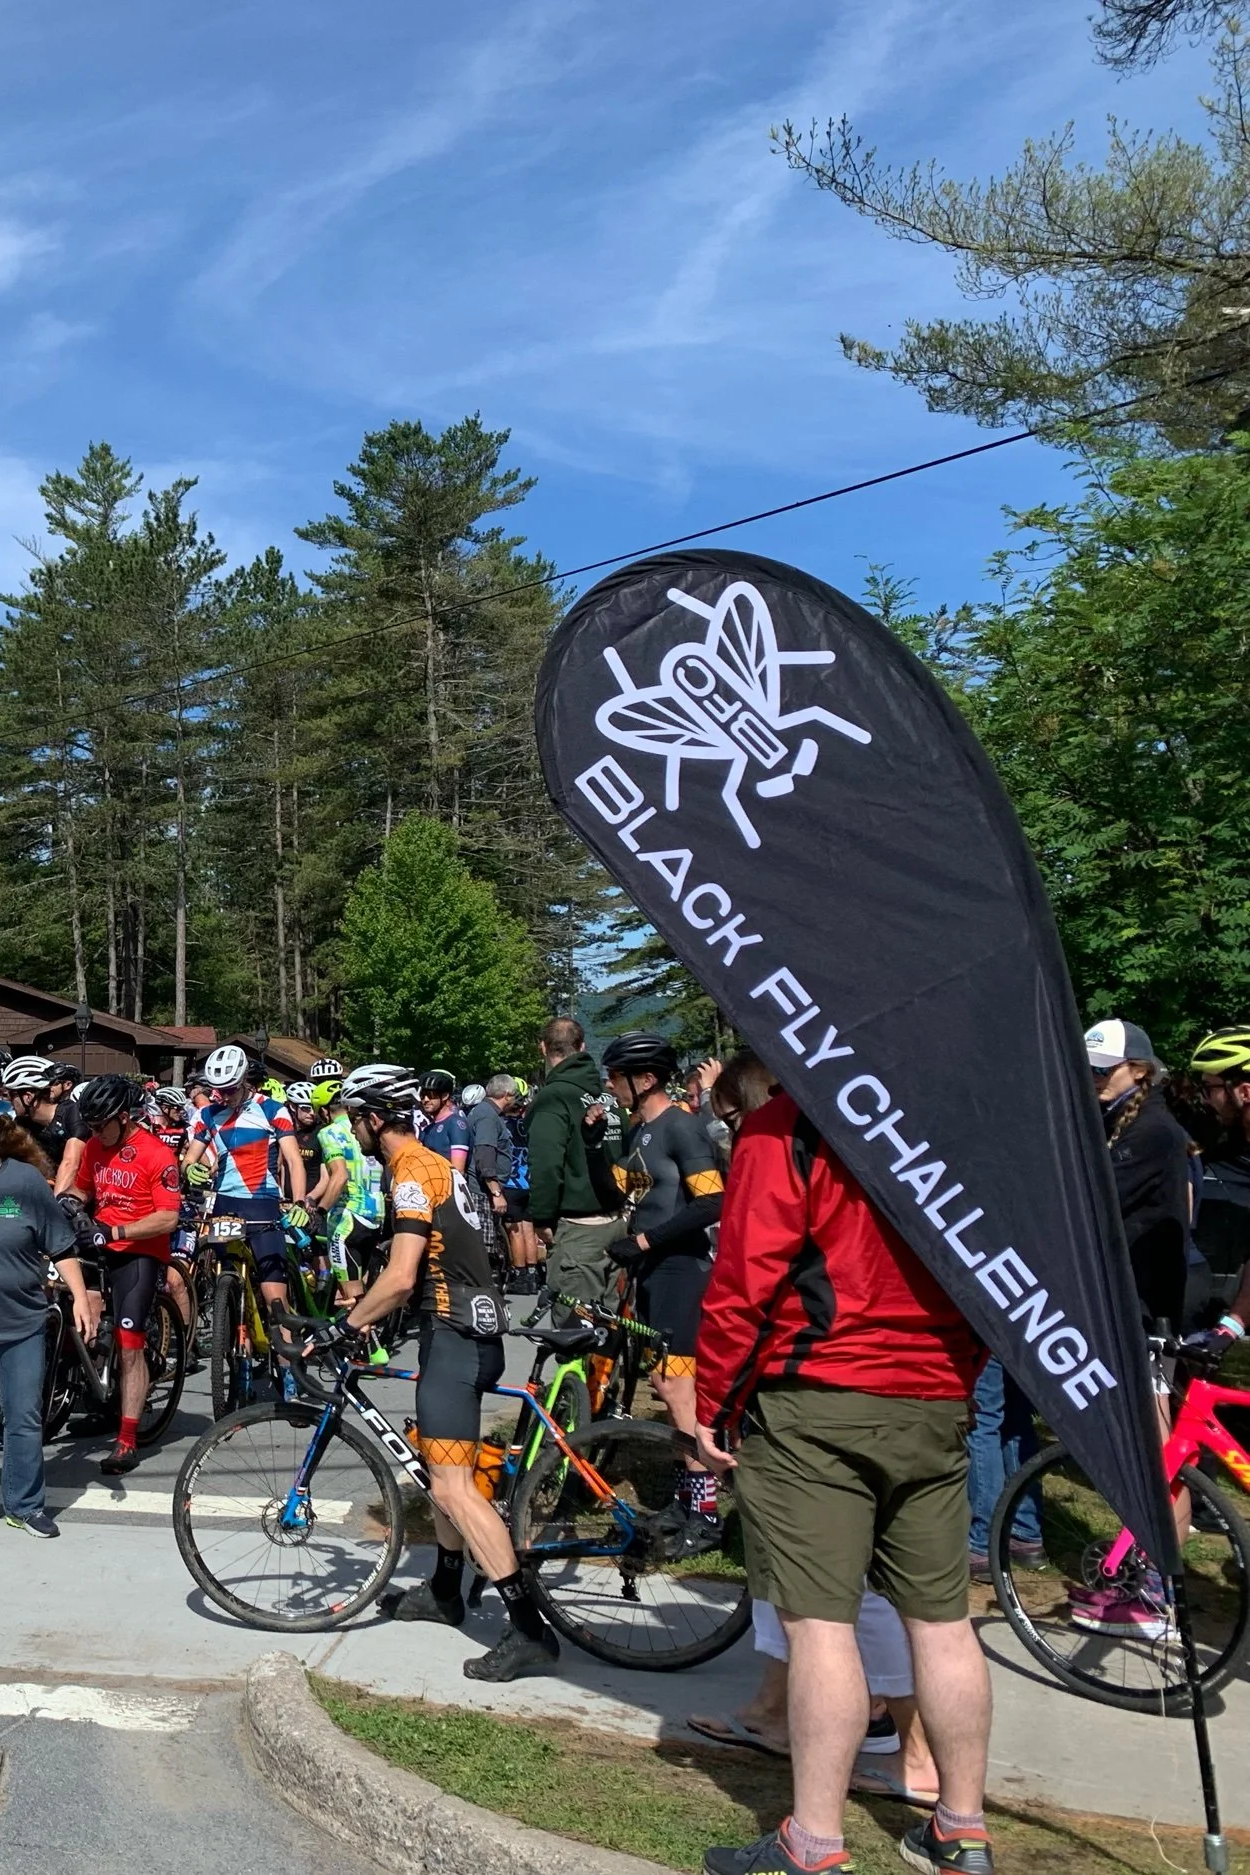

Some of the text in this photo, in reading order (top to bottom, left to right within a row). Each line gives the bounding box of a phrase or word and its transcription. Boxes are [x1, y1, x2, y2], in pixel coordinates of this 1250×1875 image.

[676, 657, 789, 770] BFC
[574, 754, 1118, 1411] BLACK FLY CHALLENGE
[213, 1221, 242, 1236] 152
[436, 1283, 451, 1318] THEM!
[361, 1408, 431, 1490] FOC
